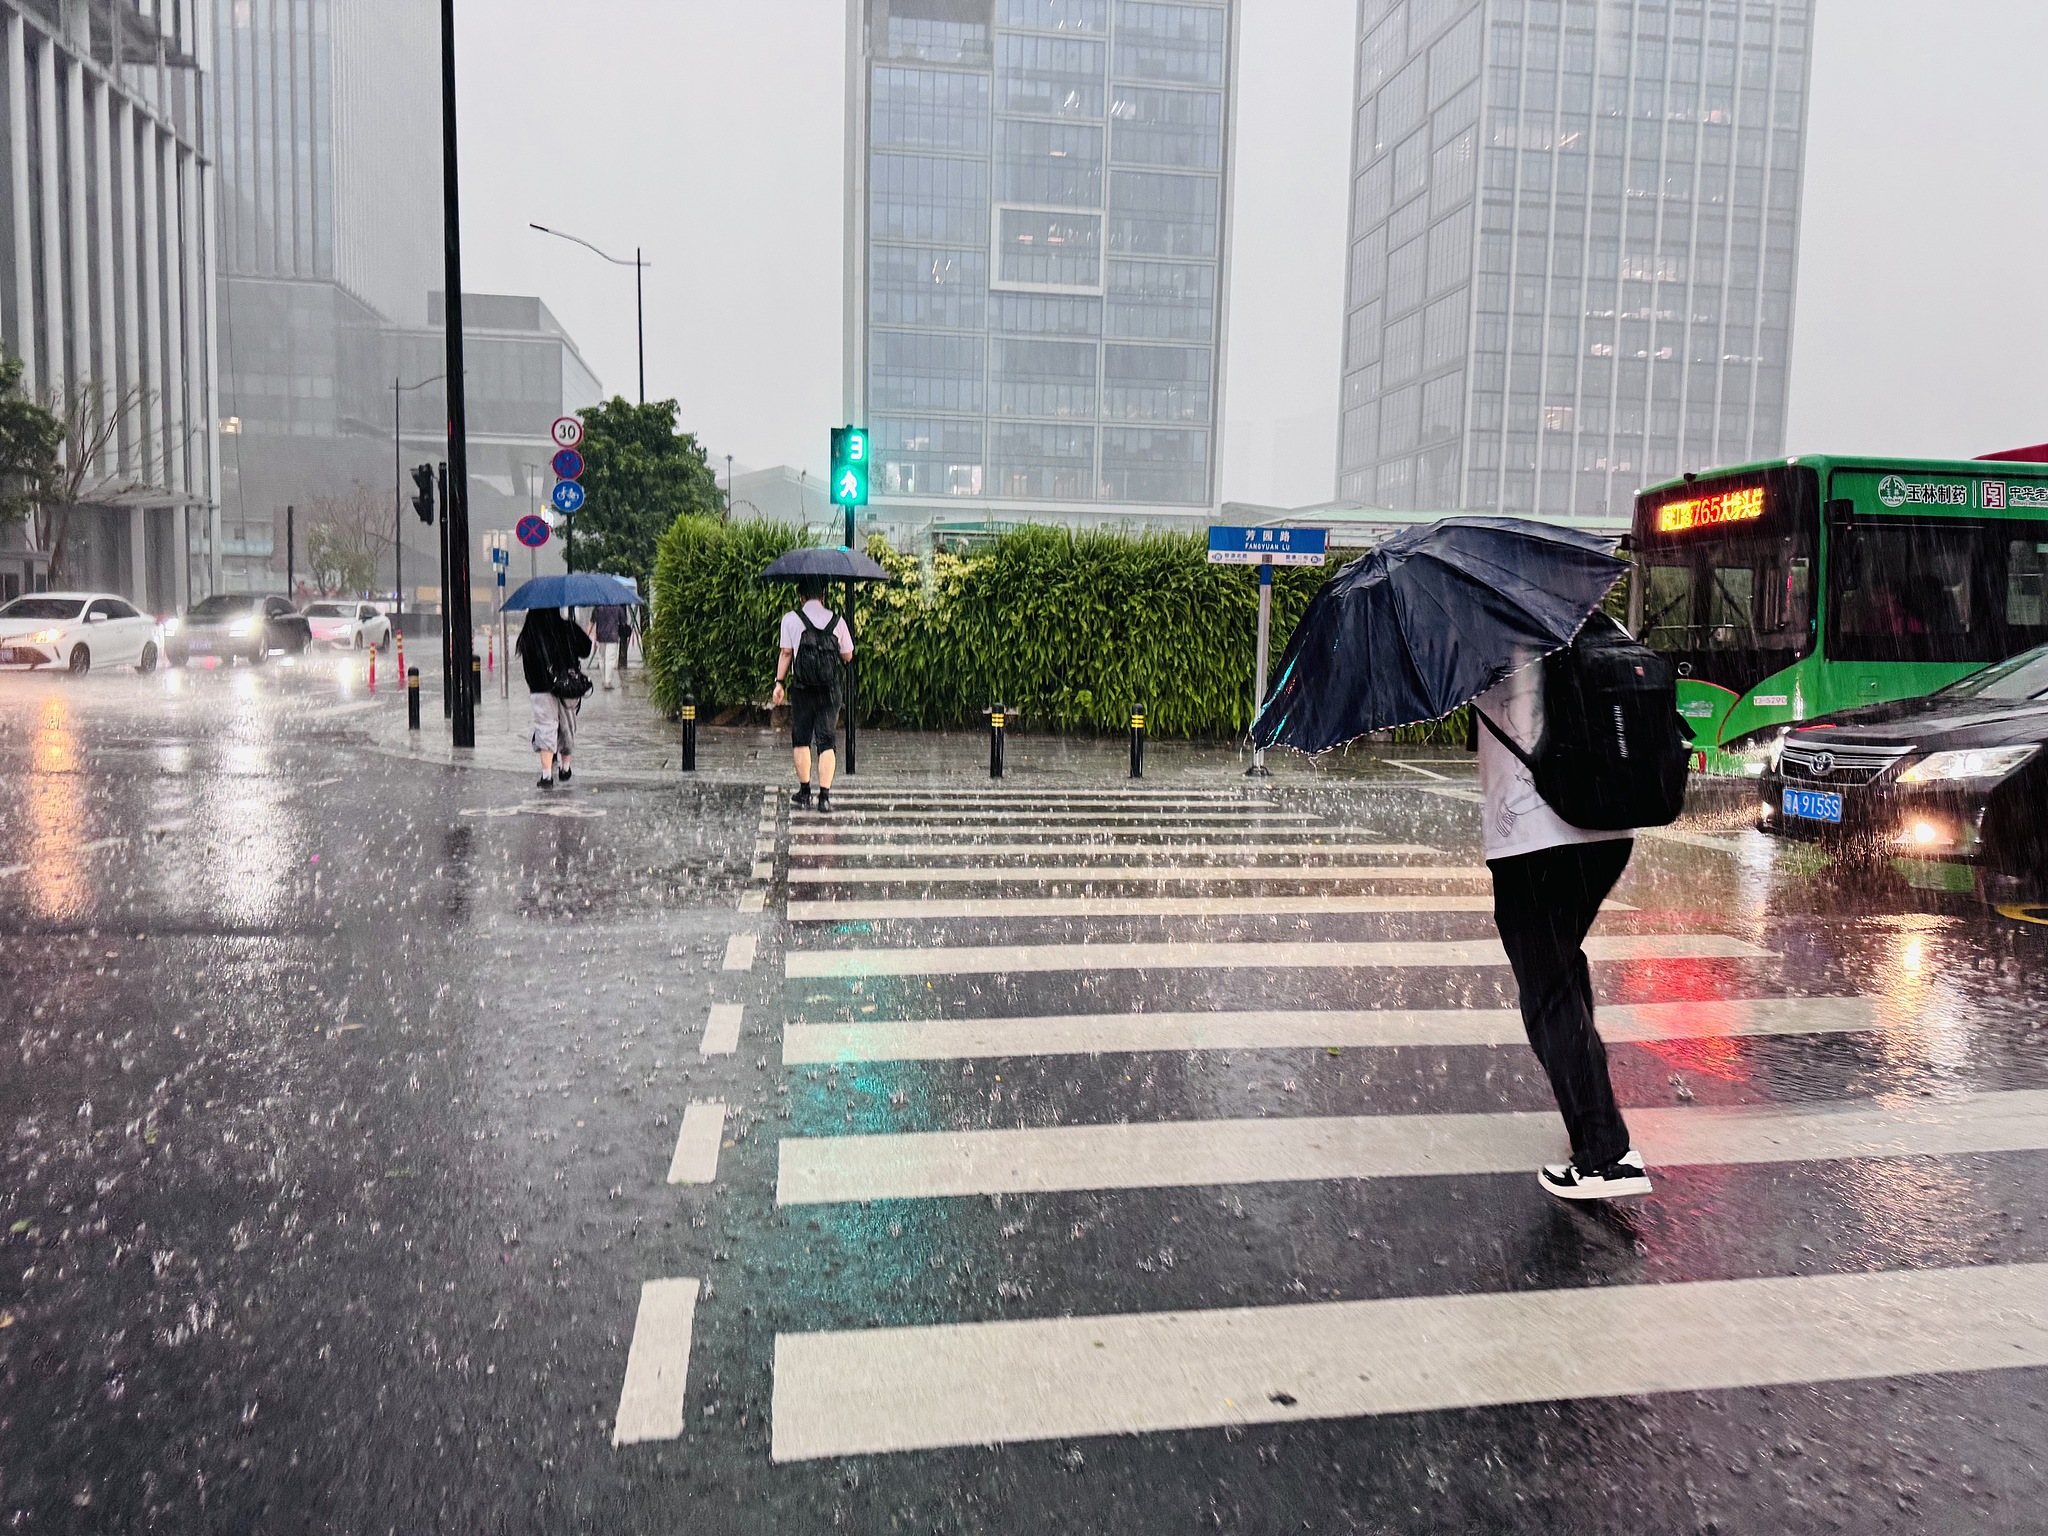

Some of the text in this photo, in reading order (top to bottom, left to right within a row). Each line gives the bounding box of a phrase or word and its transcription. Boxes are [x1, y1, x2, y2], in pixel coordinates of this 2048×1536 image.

[559, 425, 576, 439] 30
[850, 435, 863, 460] 3
[1907, 485, 1966, 505] 玉林制药
[1245, 542, 1279, 551] FANGYUAN
